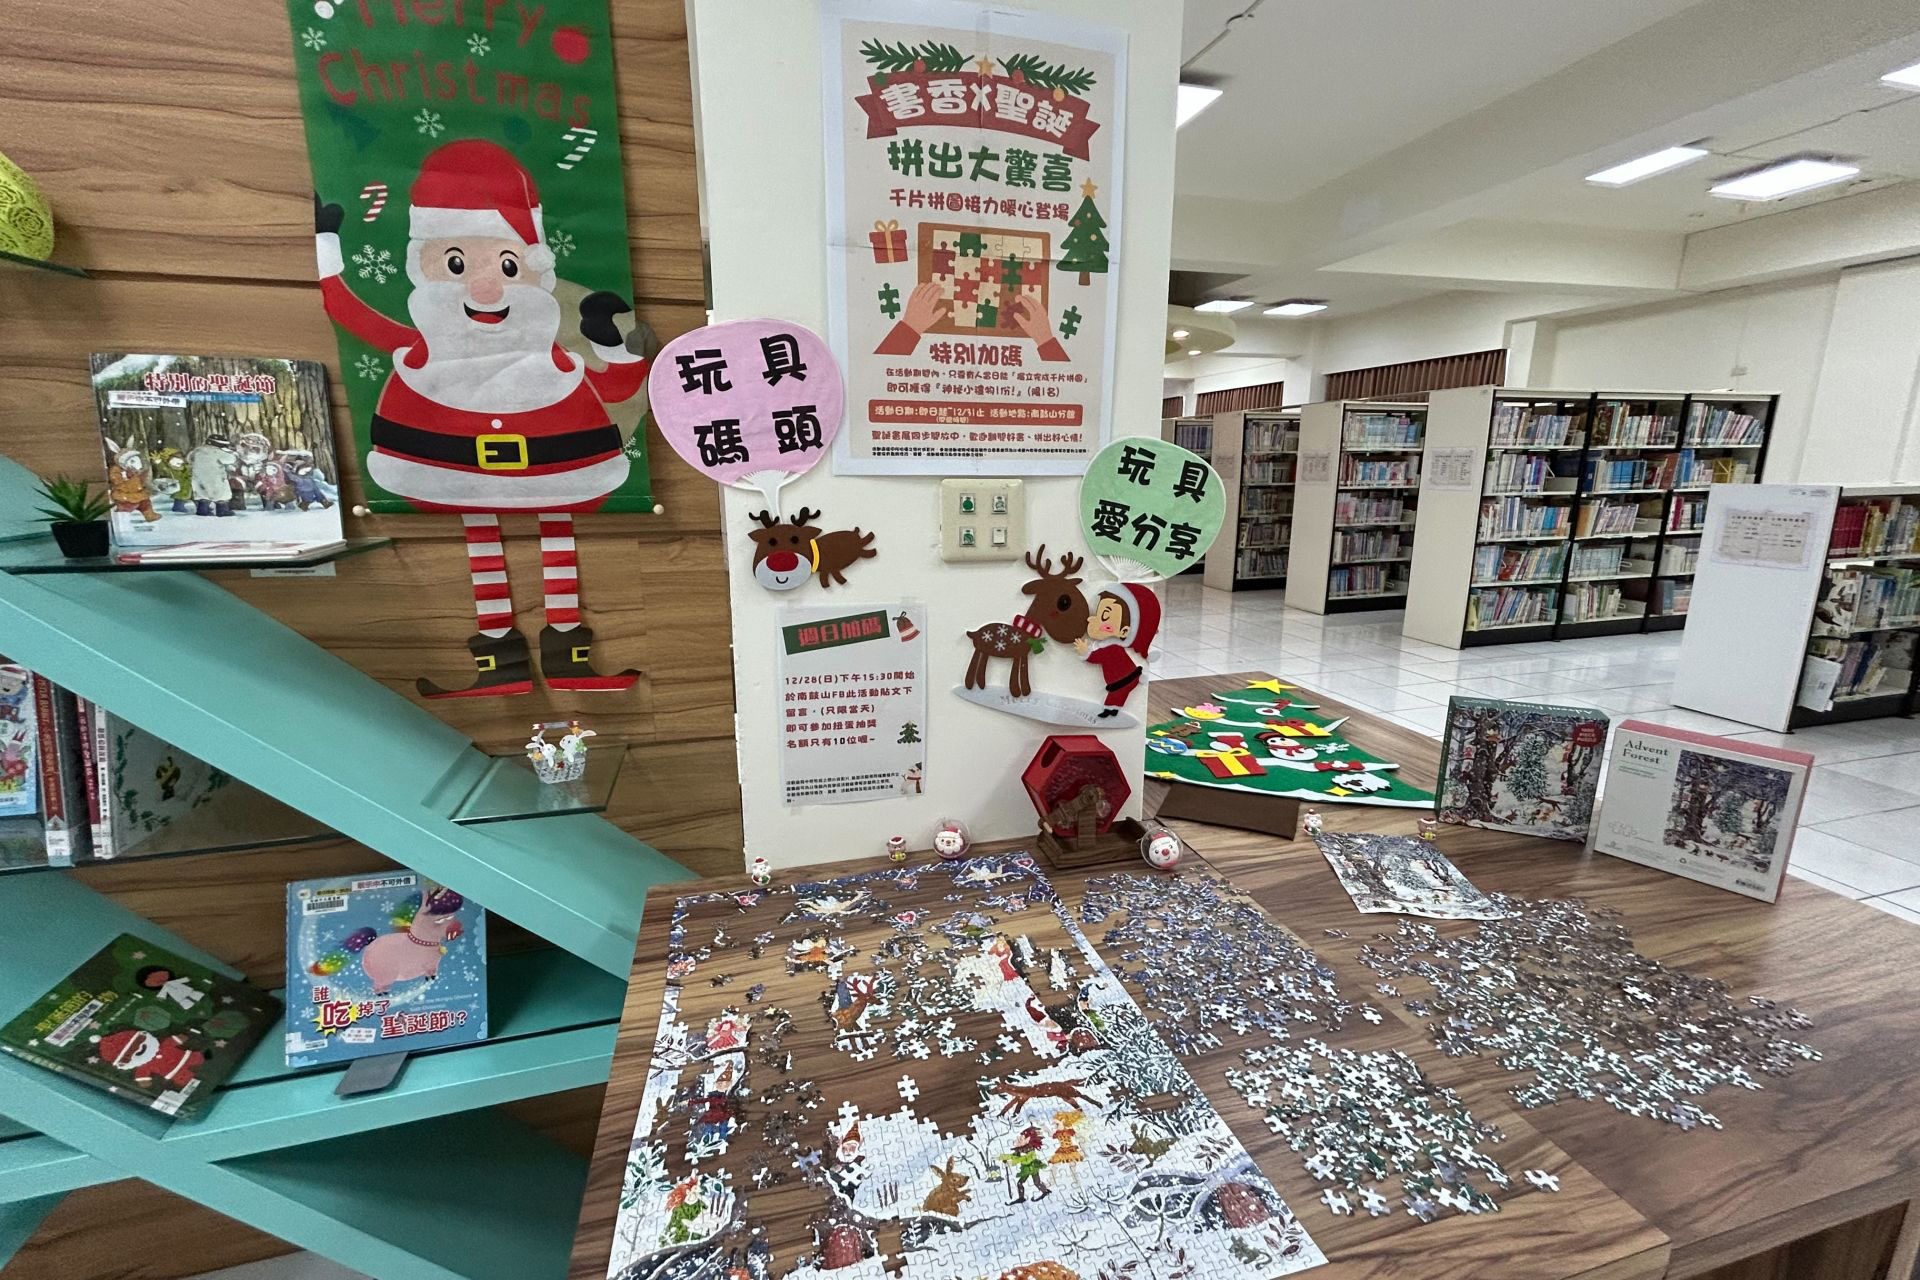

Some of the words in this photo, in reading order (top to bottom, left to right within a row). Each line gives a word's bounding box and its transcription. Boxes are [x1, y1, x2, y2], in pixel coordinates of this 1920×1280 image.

[318, 48, 592, 129] Christmas
[887, 139, 1073, 192] 拼出大驚喜
[889, 188, 1070, 221] 千片拼圖接力暖心登場
[675, 334, 807, 395] 玩具
[929, 342, 1022, 367] 特別加碼
[145, 373, 276, 394] 特別的聖誕節
[693, 405, 824, 467] 碼頭
[1117, 445, 1209, 503] 玩具
[1091, 499, 1202, 560] 愛分享
[785, 686, 913, 702] 於南鼓山FB此活動貼文下
[786, 719, 877, 733] 即可參加扭蛋抽獎
[1623, 748, 1659, 764] Forest
[1625, 740, 1668, 756] Advent
